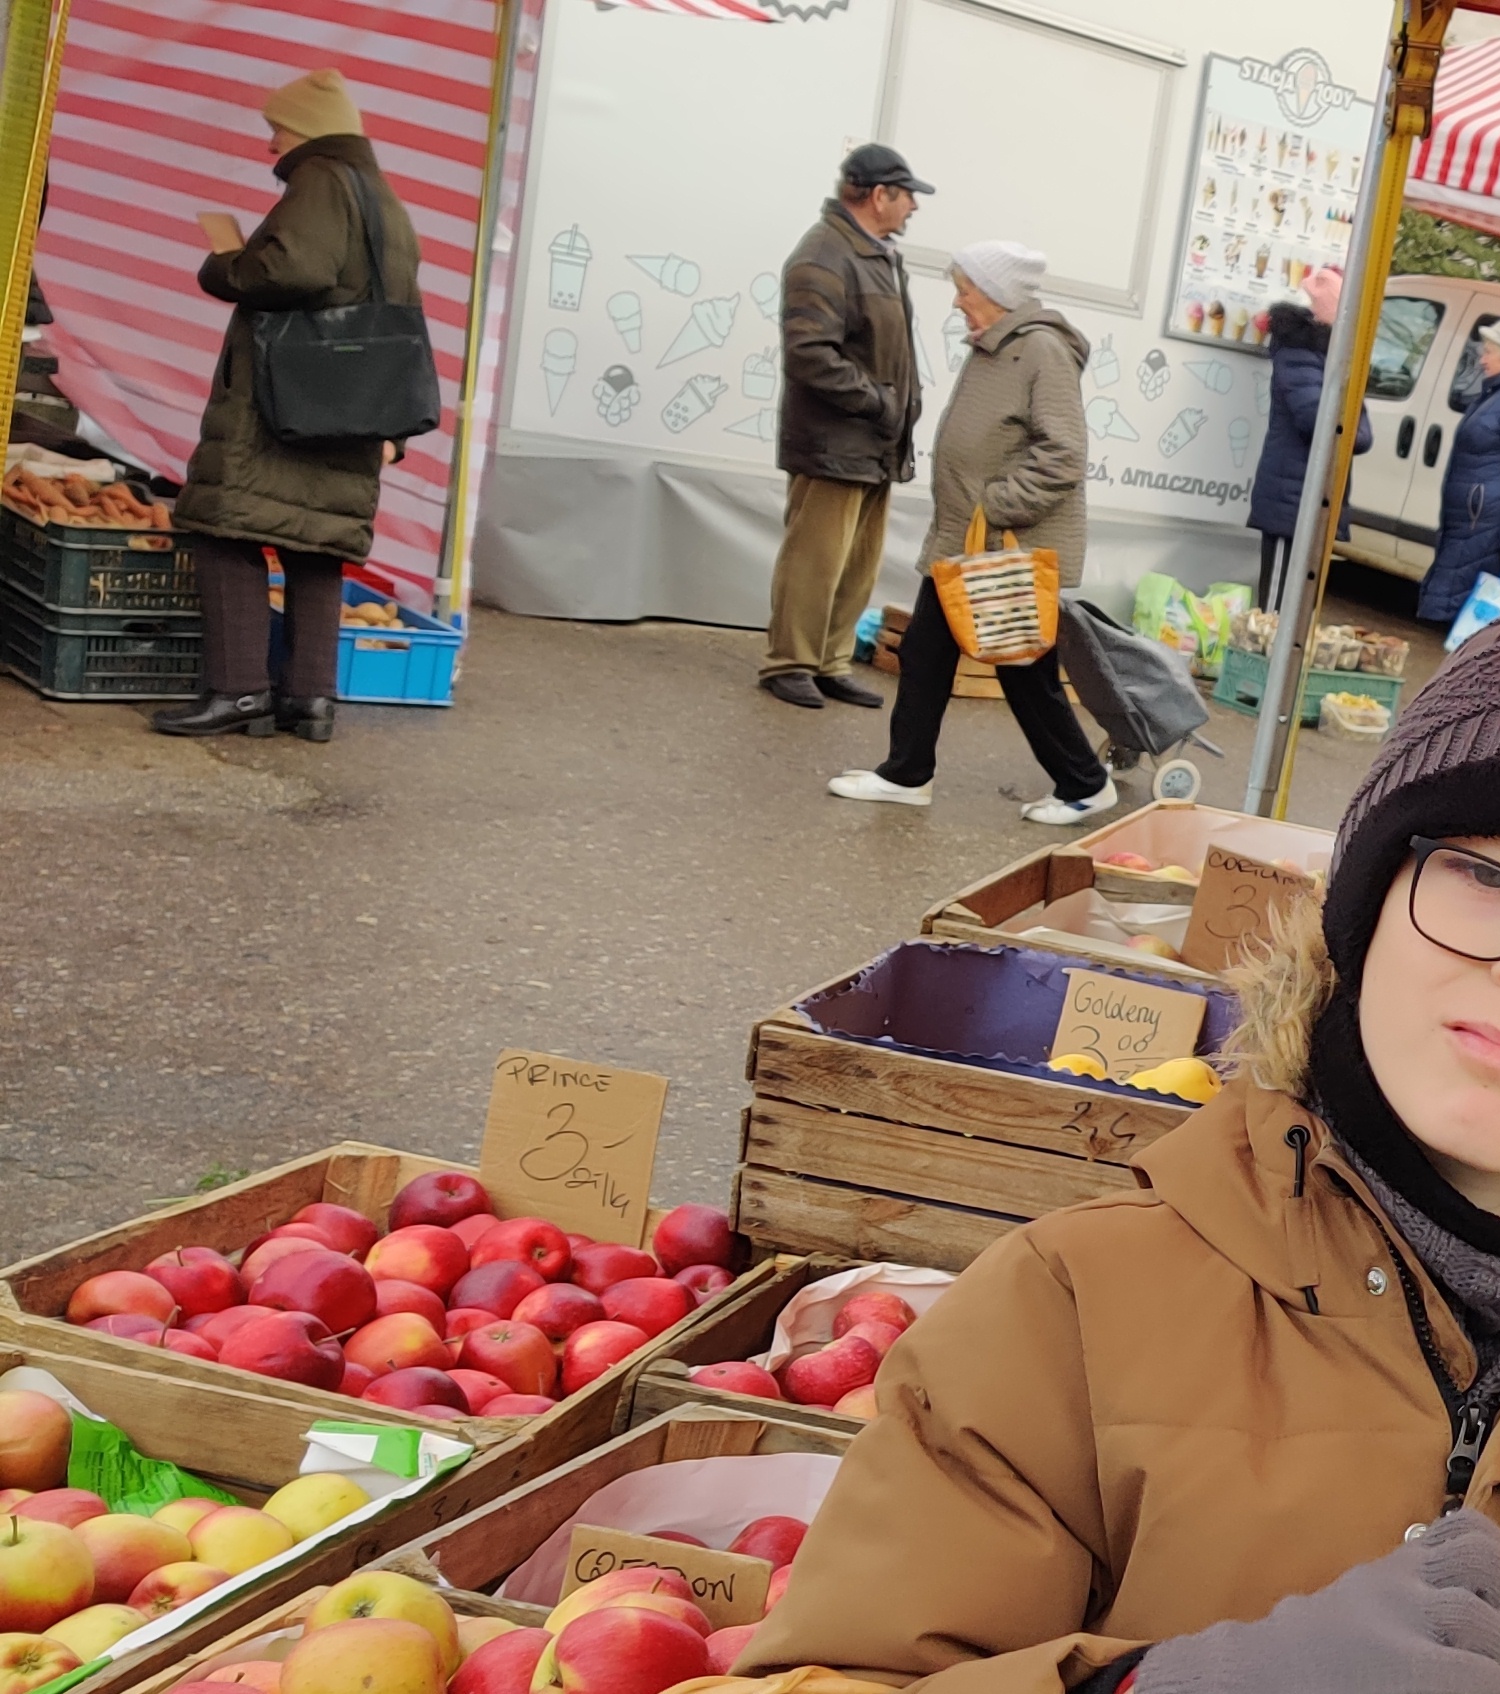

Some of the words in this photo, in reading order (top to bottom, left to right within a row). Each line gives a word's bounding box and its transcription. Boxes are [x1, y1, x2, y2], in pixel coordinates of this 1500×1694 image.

[1239, 58, 1297, 94] STACJA
[1121, 467, 1252, 506] smacznego!
[1074, 981, 1162, 1041] Goldeny
[497, 1056, 613, 1092] PRINCE
